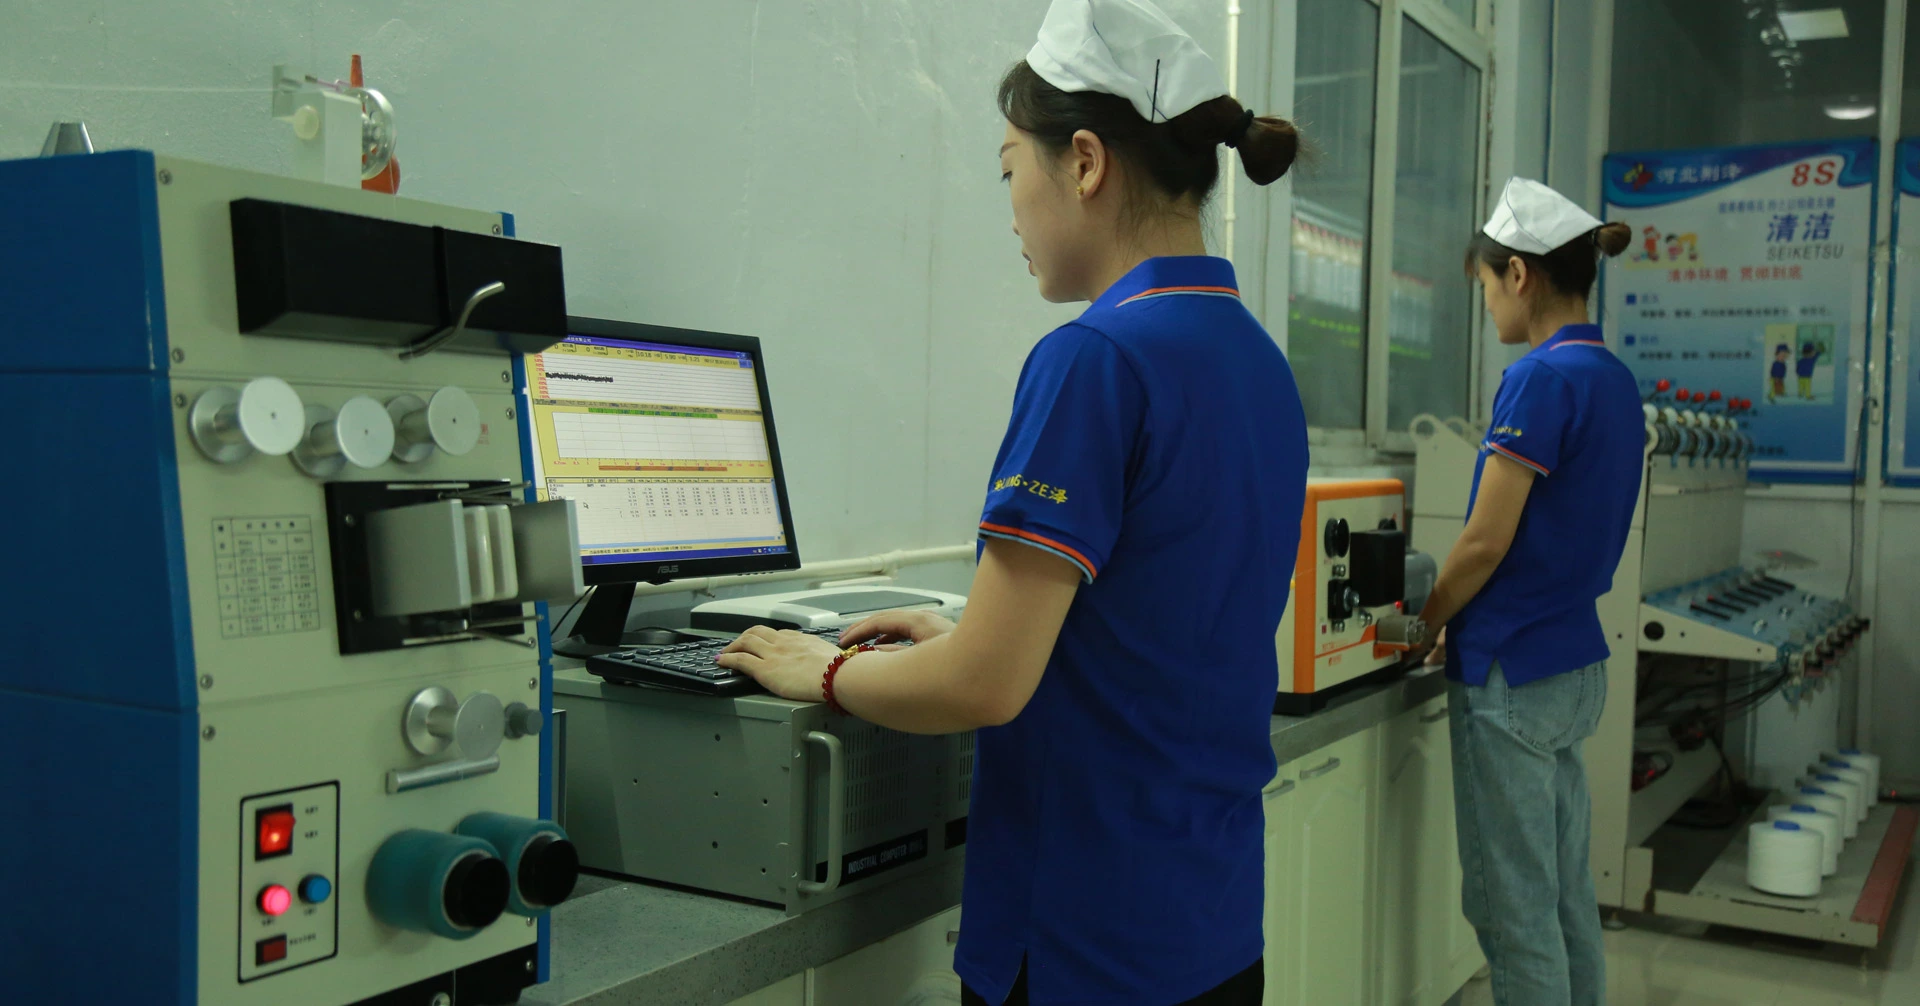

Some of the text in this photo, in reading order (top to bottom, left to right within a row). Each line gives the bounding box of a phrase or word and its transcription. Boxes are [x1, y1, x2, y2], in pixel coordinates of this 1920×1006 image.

[1791, 160, 1837, 187] 8S
[1766, 211, 1836, 243] 清洁
[1766, 243, 1845, 262] SEIKETSU
[657, 565, 679, 574] ASUS
[848, 854, 878, 875] INDUSTRIAL
[880, 843, 907, 863] COMPUTER
